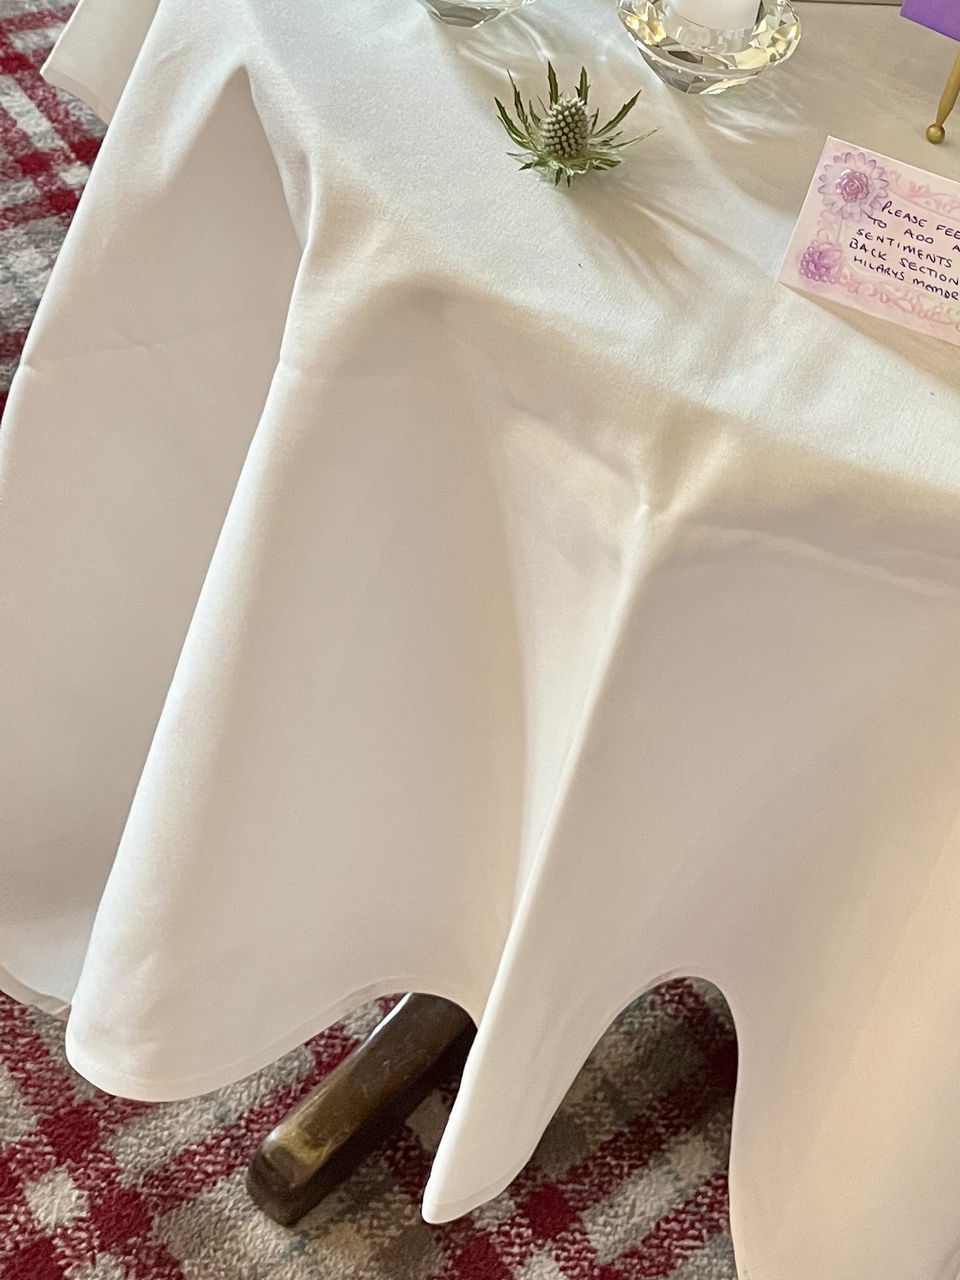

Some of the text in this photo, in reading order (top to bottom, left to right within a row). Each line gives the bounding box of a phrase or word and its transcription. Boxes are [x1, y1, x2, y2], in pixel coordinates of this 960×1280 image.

[864, 211, 888, 229] TO
[881, 200, 928, 228] PLEASE
[849, 237, 888, 261] BACK
[899, 257, 960, 286] SECTION
[856, 228, 953, 269] SENTIMENTS
[853, 255, 905, 281] HILARYS
